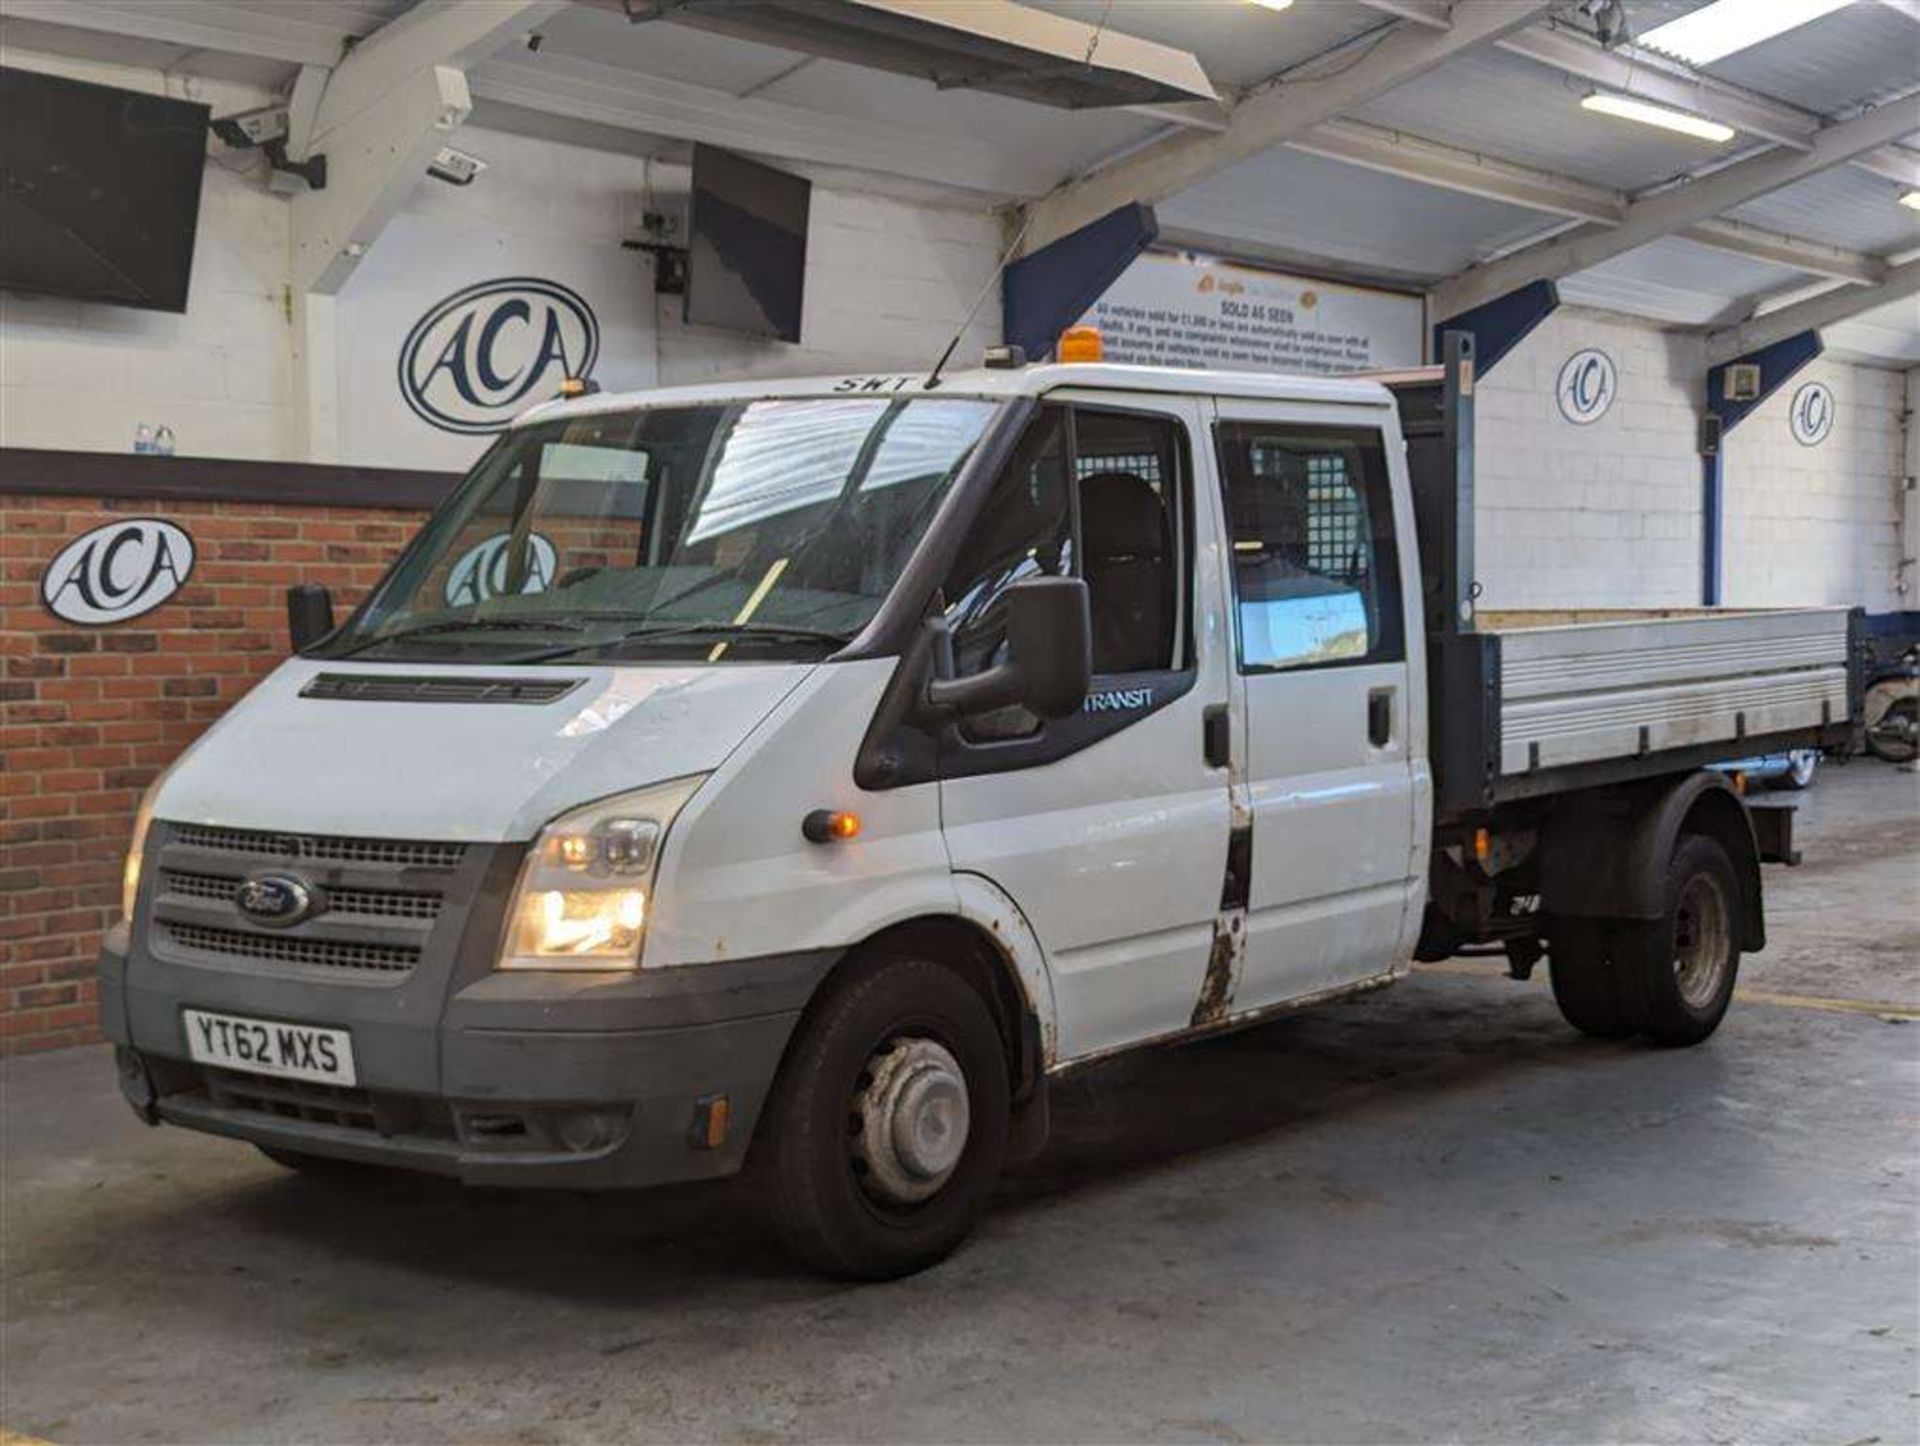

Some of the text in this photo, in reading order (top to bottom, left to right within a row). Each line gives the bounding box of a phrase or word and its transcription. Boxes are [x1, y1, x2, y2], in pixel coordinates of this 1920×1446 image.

[1221, 300, 1294, 324] SOLD AS SEEN
[418, 298, 571, 409] ACA
[833, 377, 918, 391] SWT
[50, 526, 180, 611] ACA
[1083, 689, 1153, 712] TRANSIT
[198, 1015, 338, 1072] YT62 MXS
